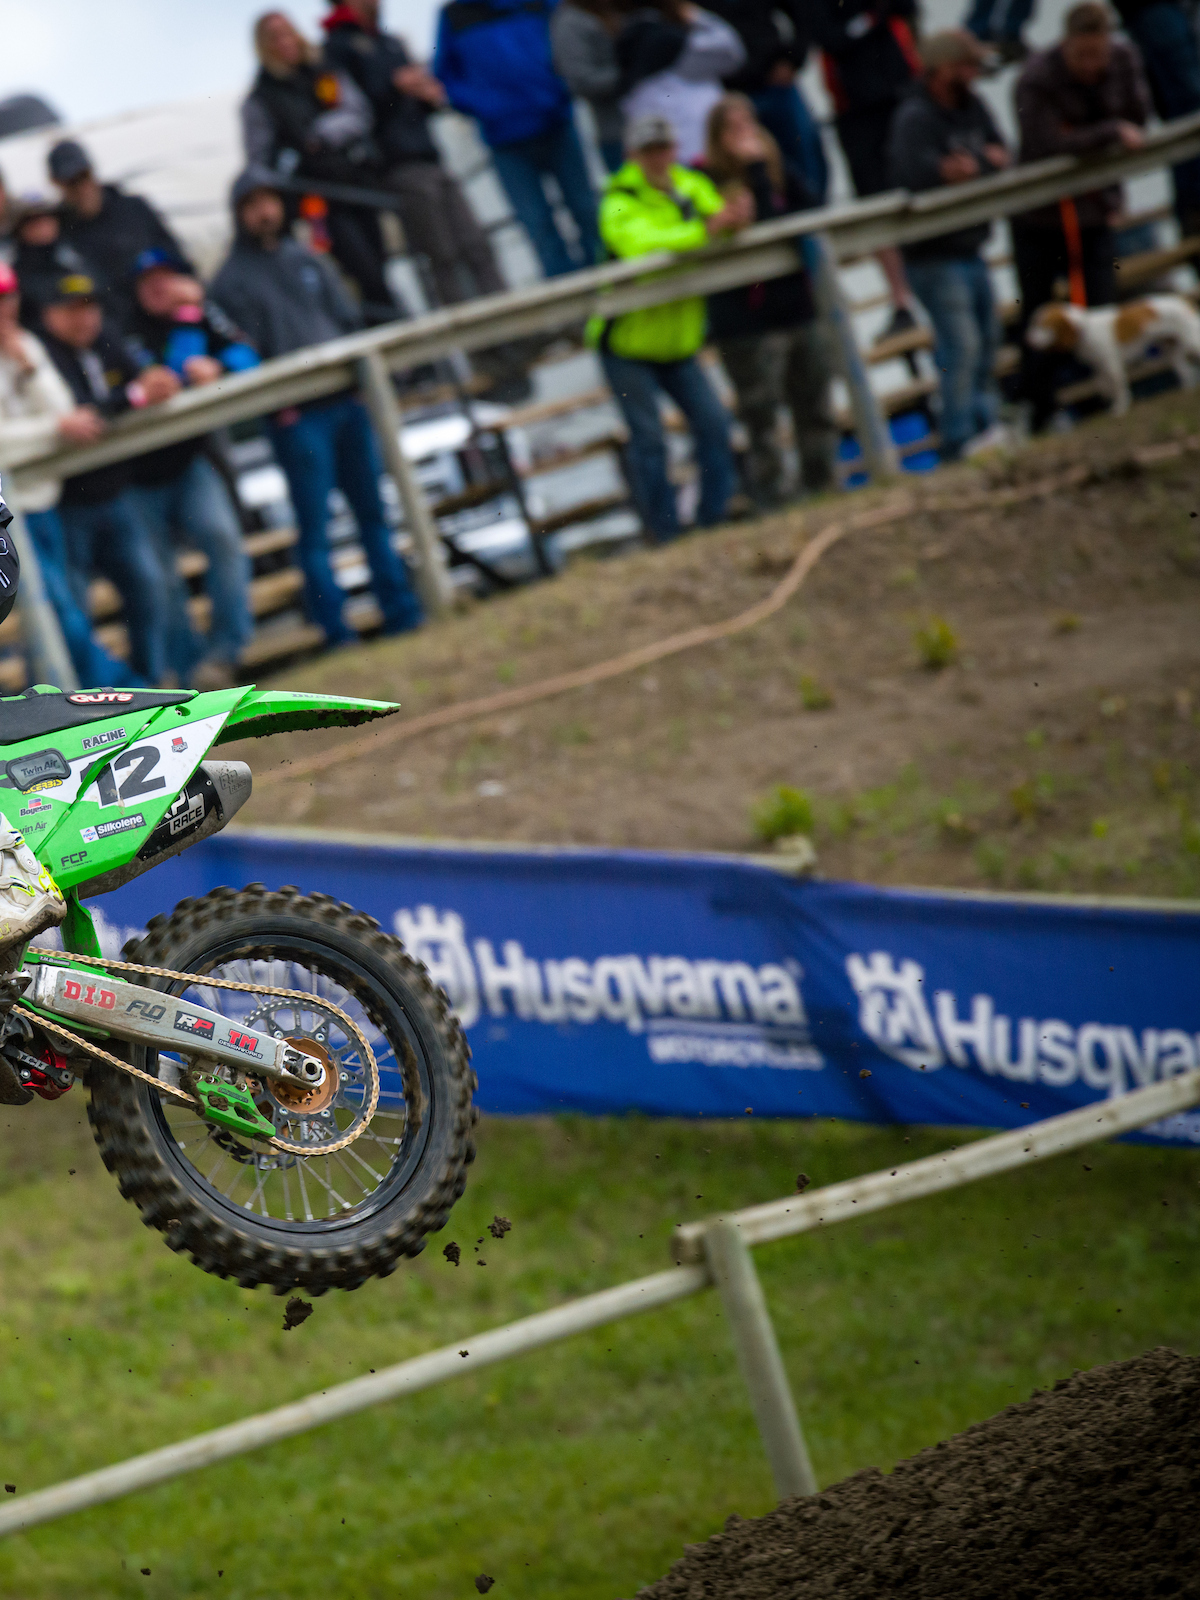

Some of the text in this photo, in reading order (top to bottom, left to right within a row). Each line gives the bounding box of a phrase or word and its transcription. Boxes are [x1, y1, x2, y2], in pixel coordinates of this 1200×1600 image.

[81, 728, 127, 751] RACINE
[21, 765, 43, 777] Twin
[44, 759, 58, 770] Air
[79, 745, 167, 807] 12
[20, 803, 52, 817] Boyesen
[173, 805, 203, 831] RACE
[97, 815, 143, 834] Silkolene
[60, 850, 88, 867] FCP
[474, 937, 809, 1035] Husqvarna
[125, 999, 167, 1021] FLO
[176, 1012, 214, 1030] RP
[228, 1028, 259, 1052] TM
